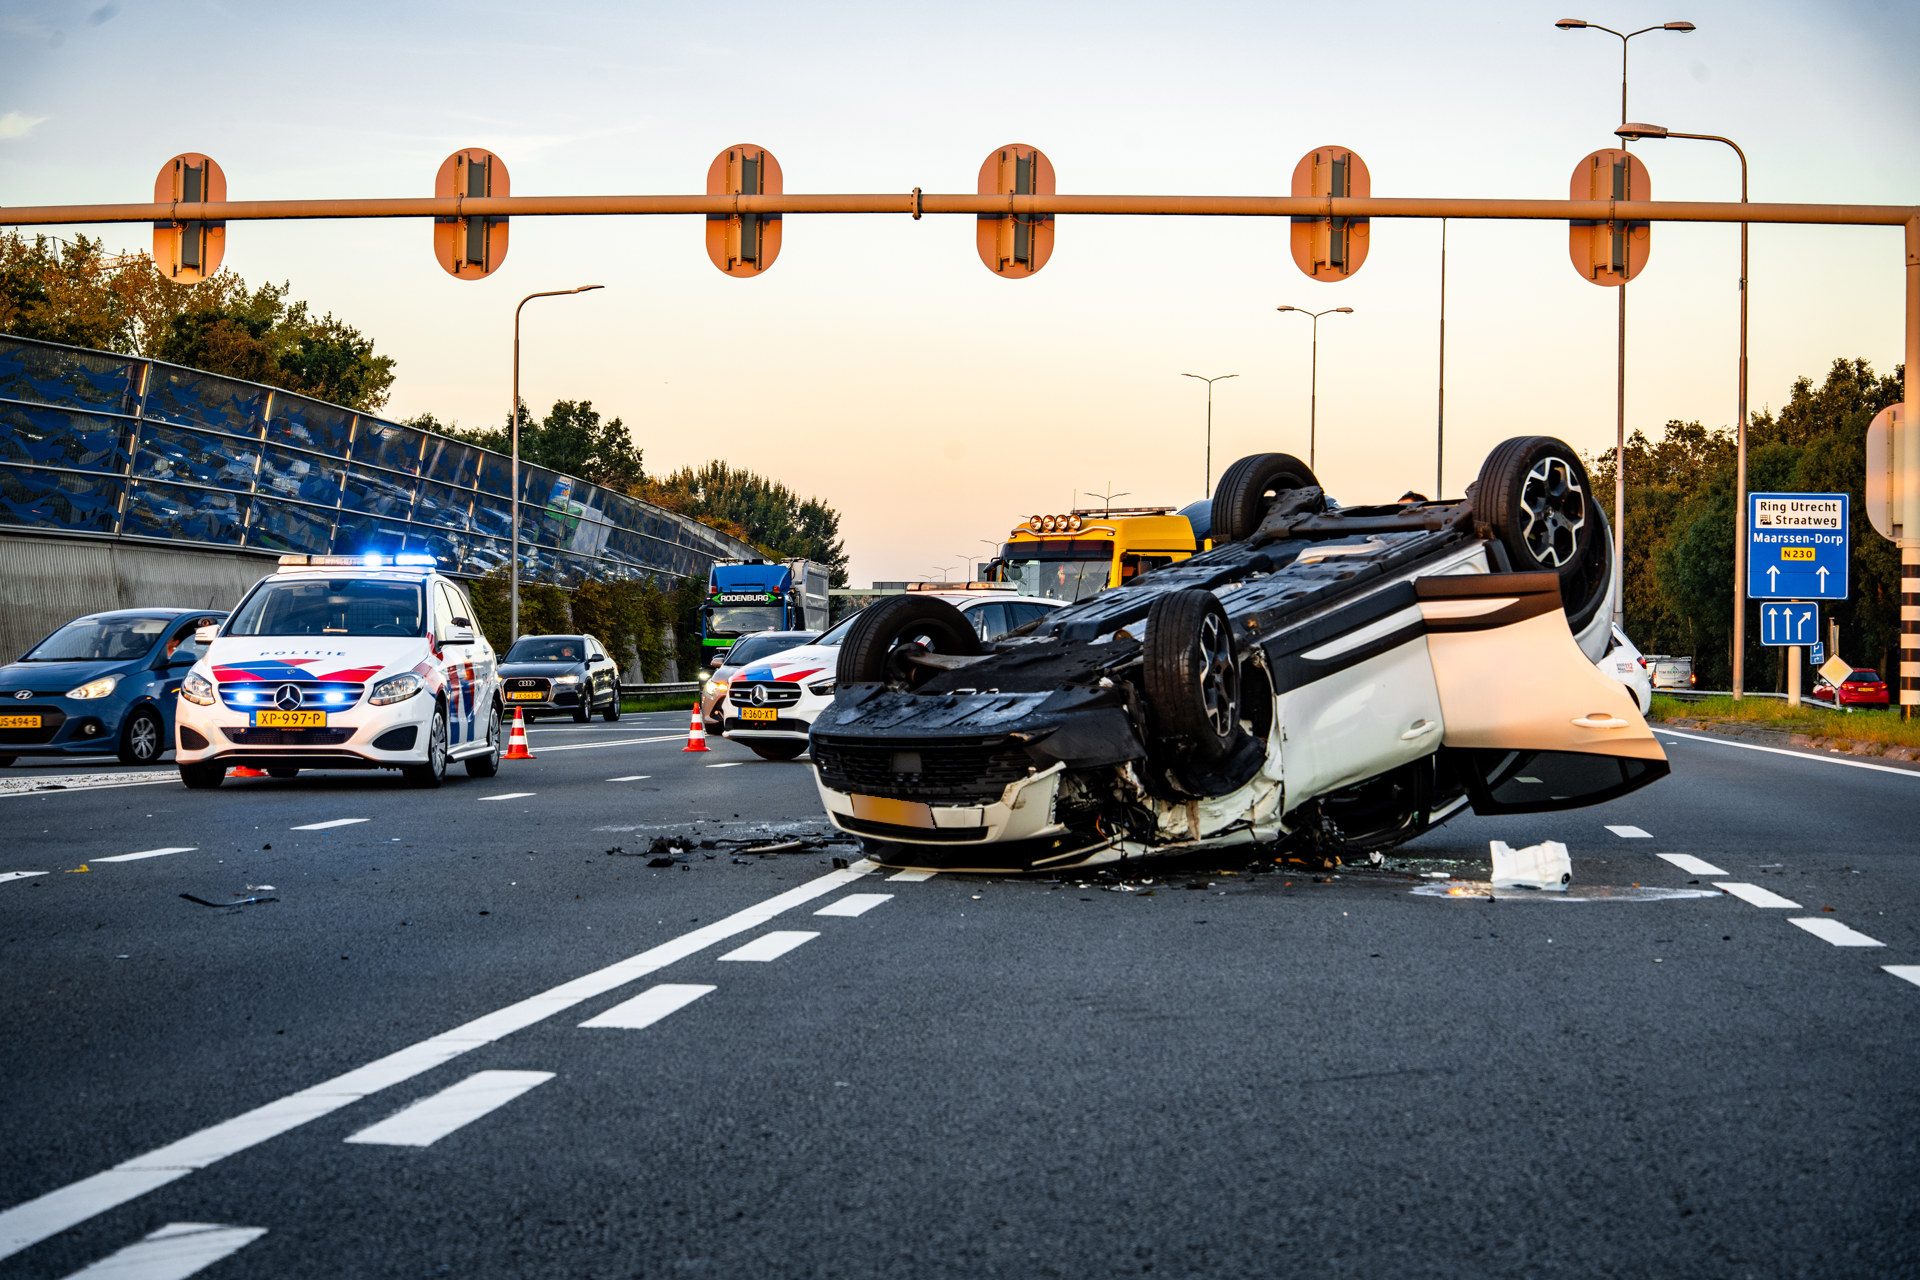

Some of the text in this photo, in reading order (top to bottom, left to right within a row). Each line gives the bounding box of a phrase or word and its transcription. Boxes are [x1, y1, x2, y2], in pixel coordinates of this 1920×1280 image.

[1760, 501, 1837, 513] Ring Utrecht
[1775, 515, 1837, 527] Straatweg
[1753, 532, 1844, 546] Maarssen-Dorp
[720, 594, 769, 602] RODENBURG
[261, 713, 321, 725] XP-997-P
[742, 710, 774, 719] R-360-XT
